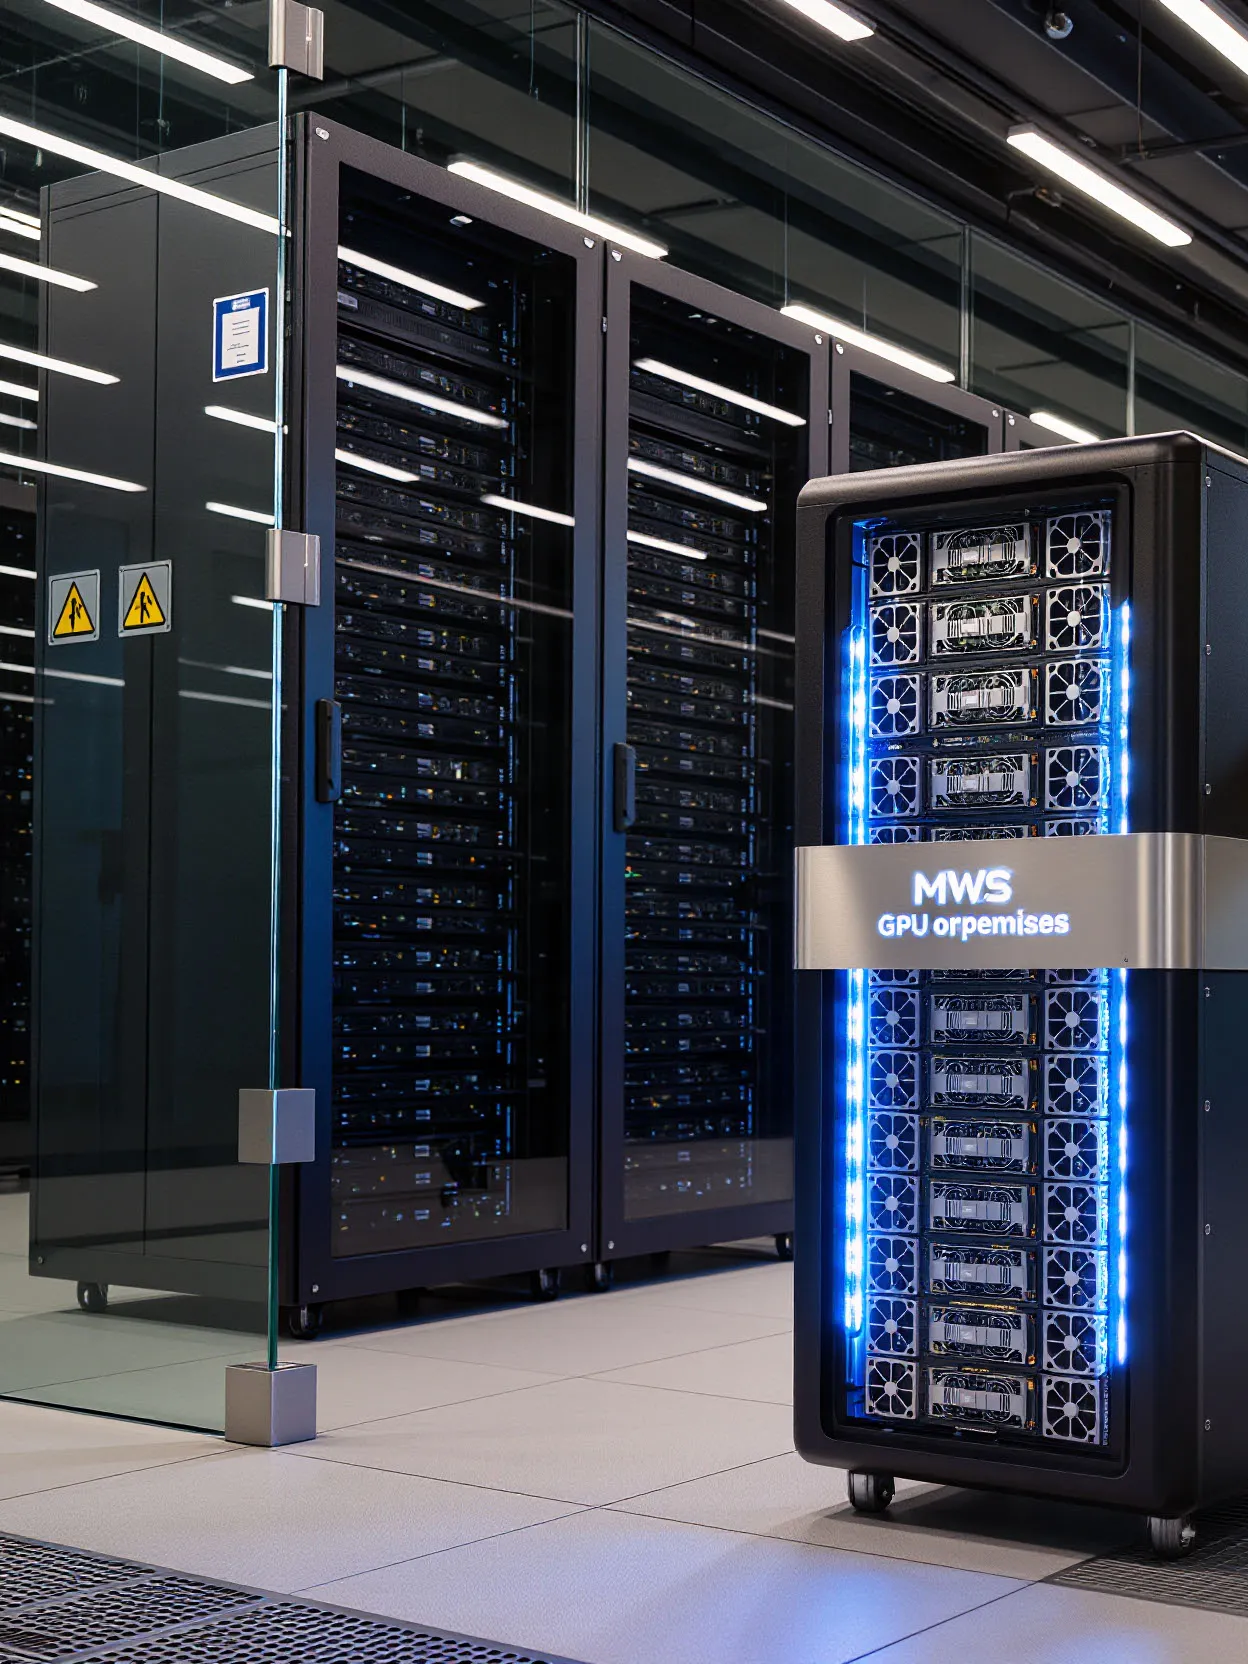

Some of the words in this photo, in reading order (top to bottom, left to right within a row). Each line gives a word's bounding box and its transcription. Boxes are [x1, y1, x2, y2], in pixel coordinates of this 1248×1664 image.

[913, 868, 1013, 905] MWS
[877, 912, 929, 937] GPU
[932, 908, 1070, 941] orpemises
